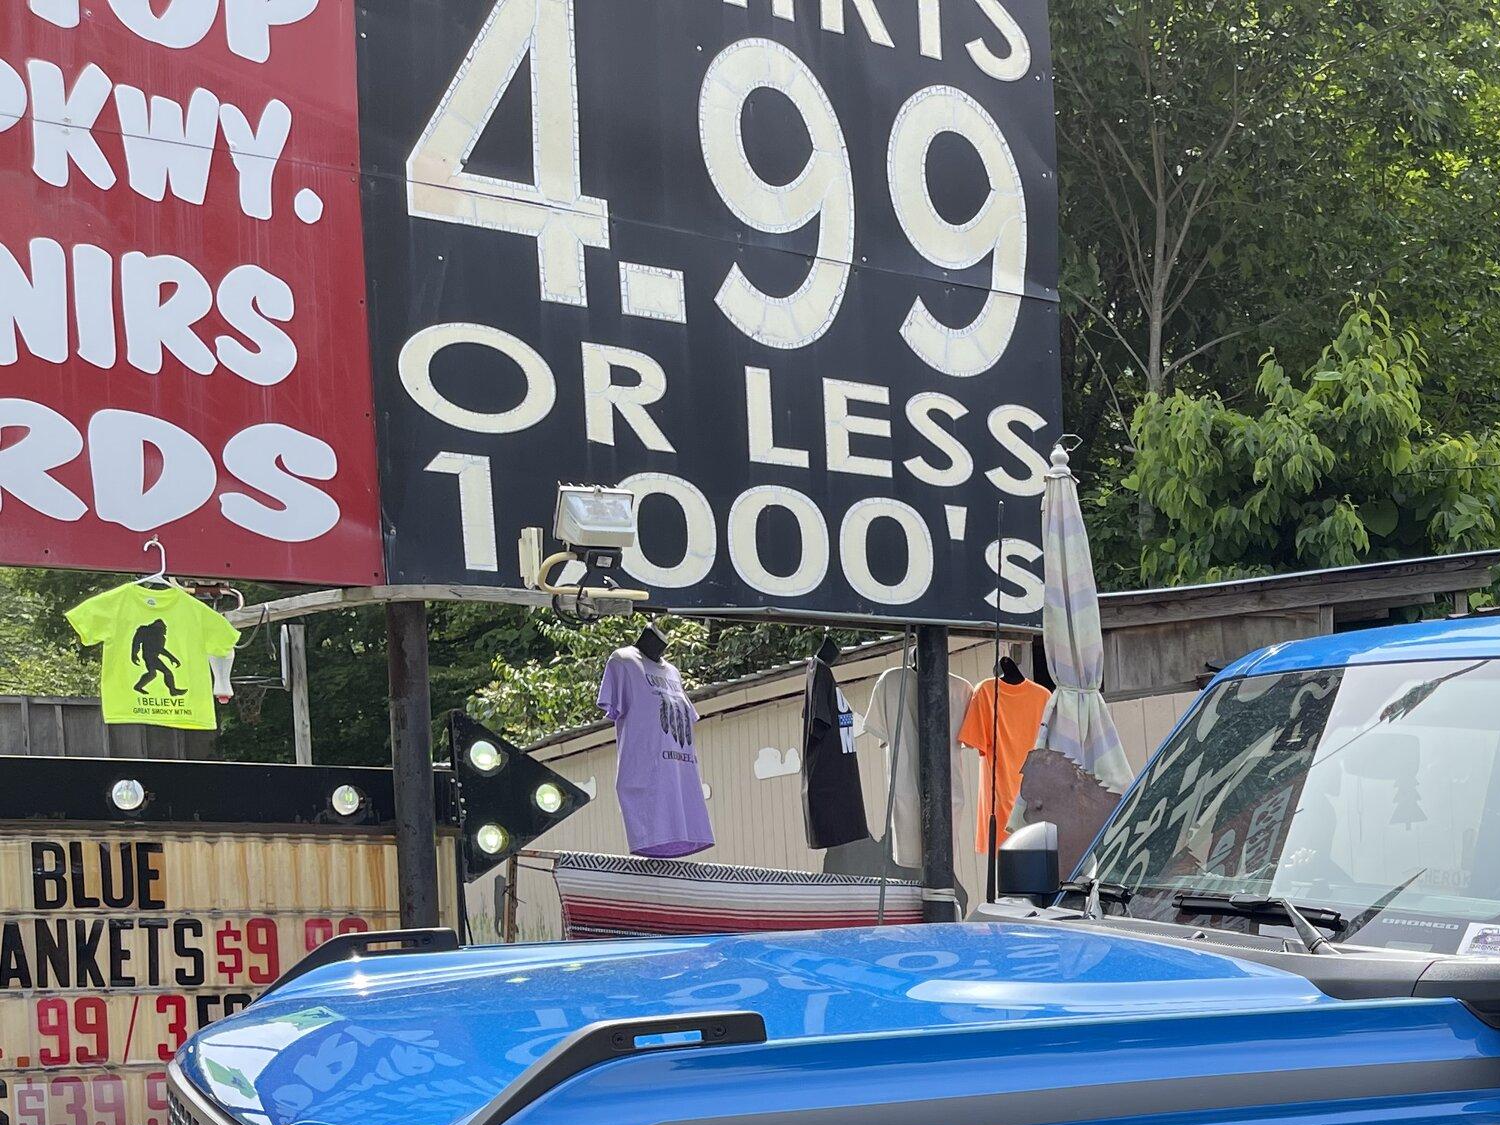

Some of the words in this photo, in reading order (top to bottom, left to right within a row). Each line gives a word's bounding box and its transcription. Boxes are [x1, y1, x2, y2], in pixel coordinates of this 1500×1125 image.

[406, 0, 1028, 376] 4.99
[398, 322, 677, 453] OR
[745, 366, 1051, 498] LESS
[142, 698, 185, 707] BELIEVE
[31, 841, 165, 910] BLUE
[0, 918, 205, 989] ANKETS
[1382, 917, 1460, 931] BRONCO
